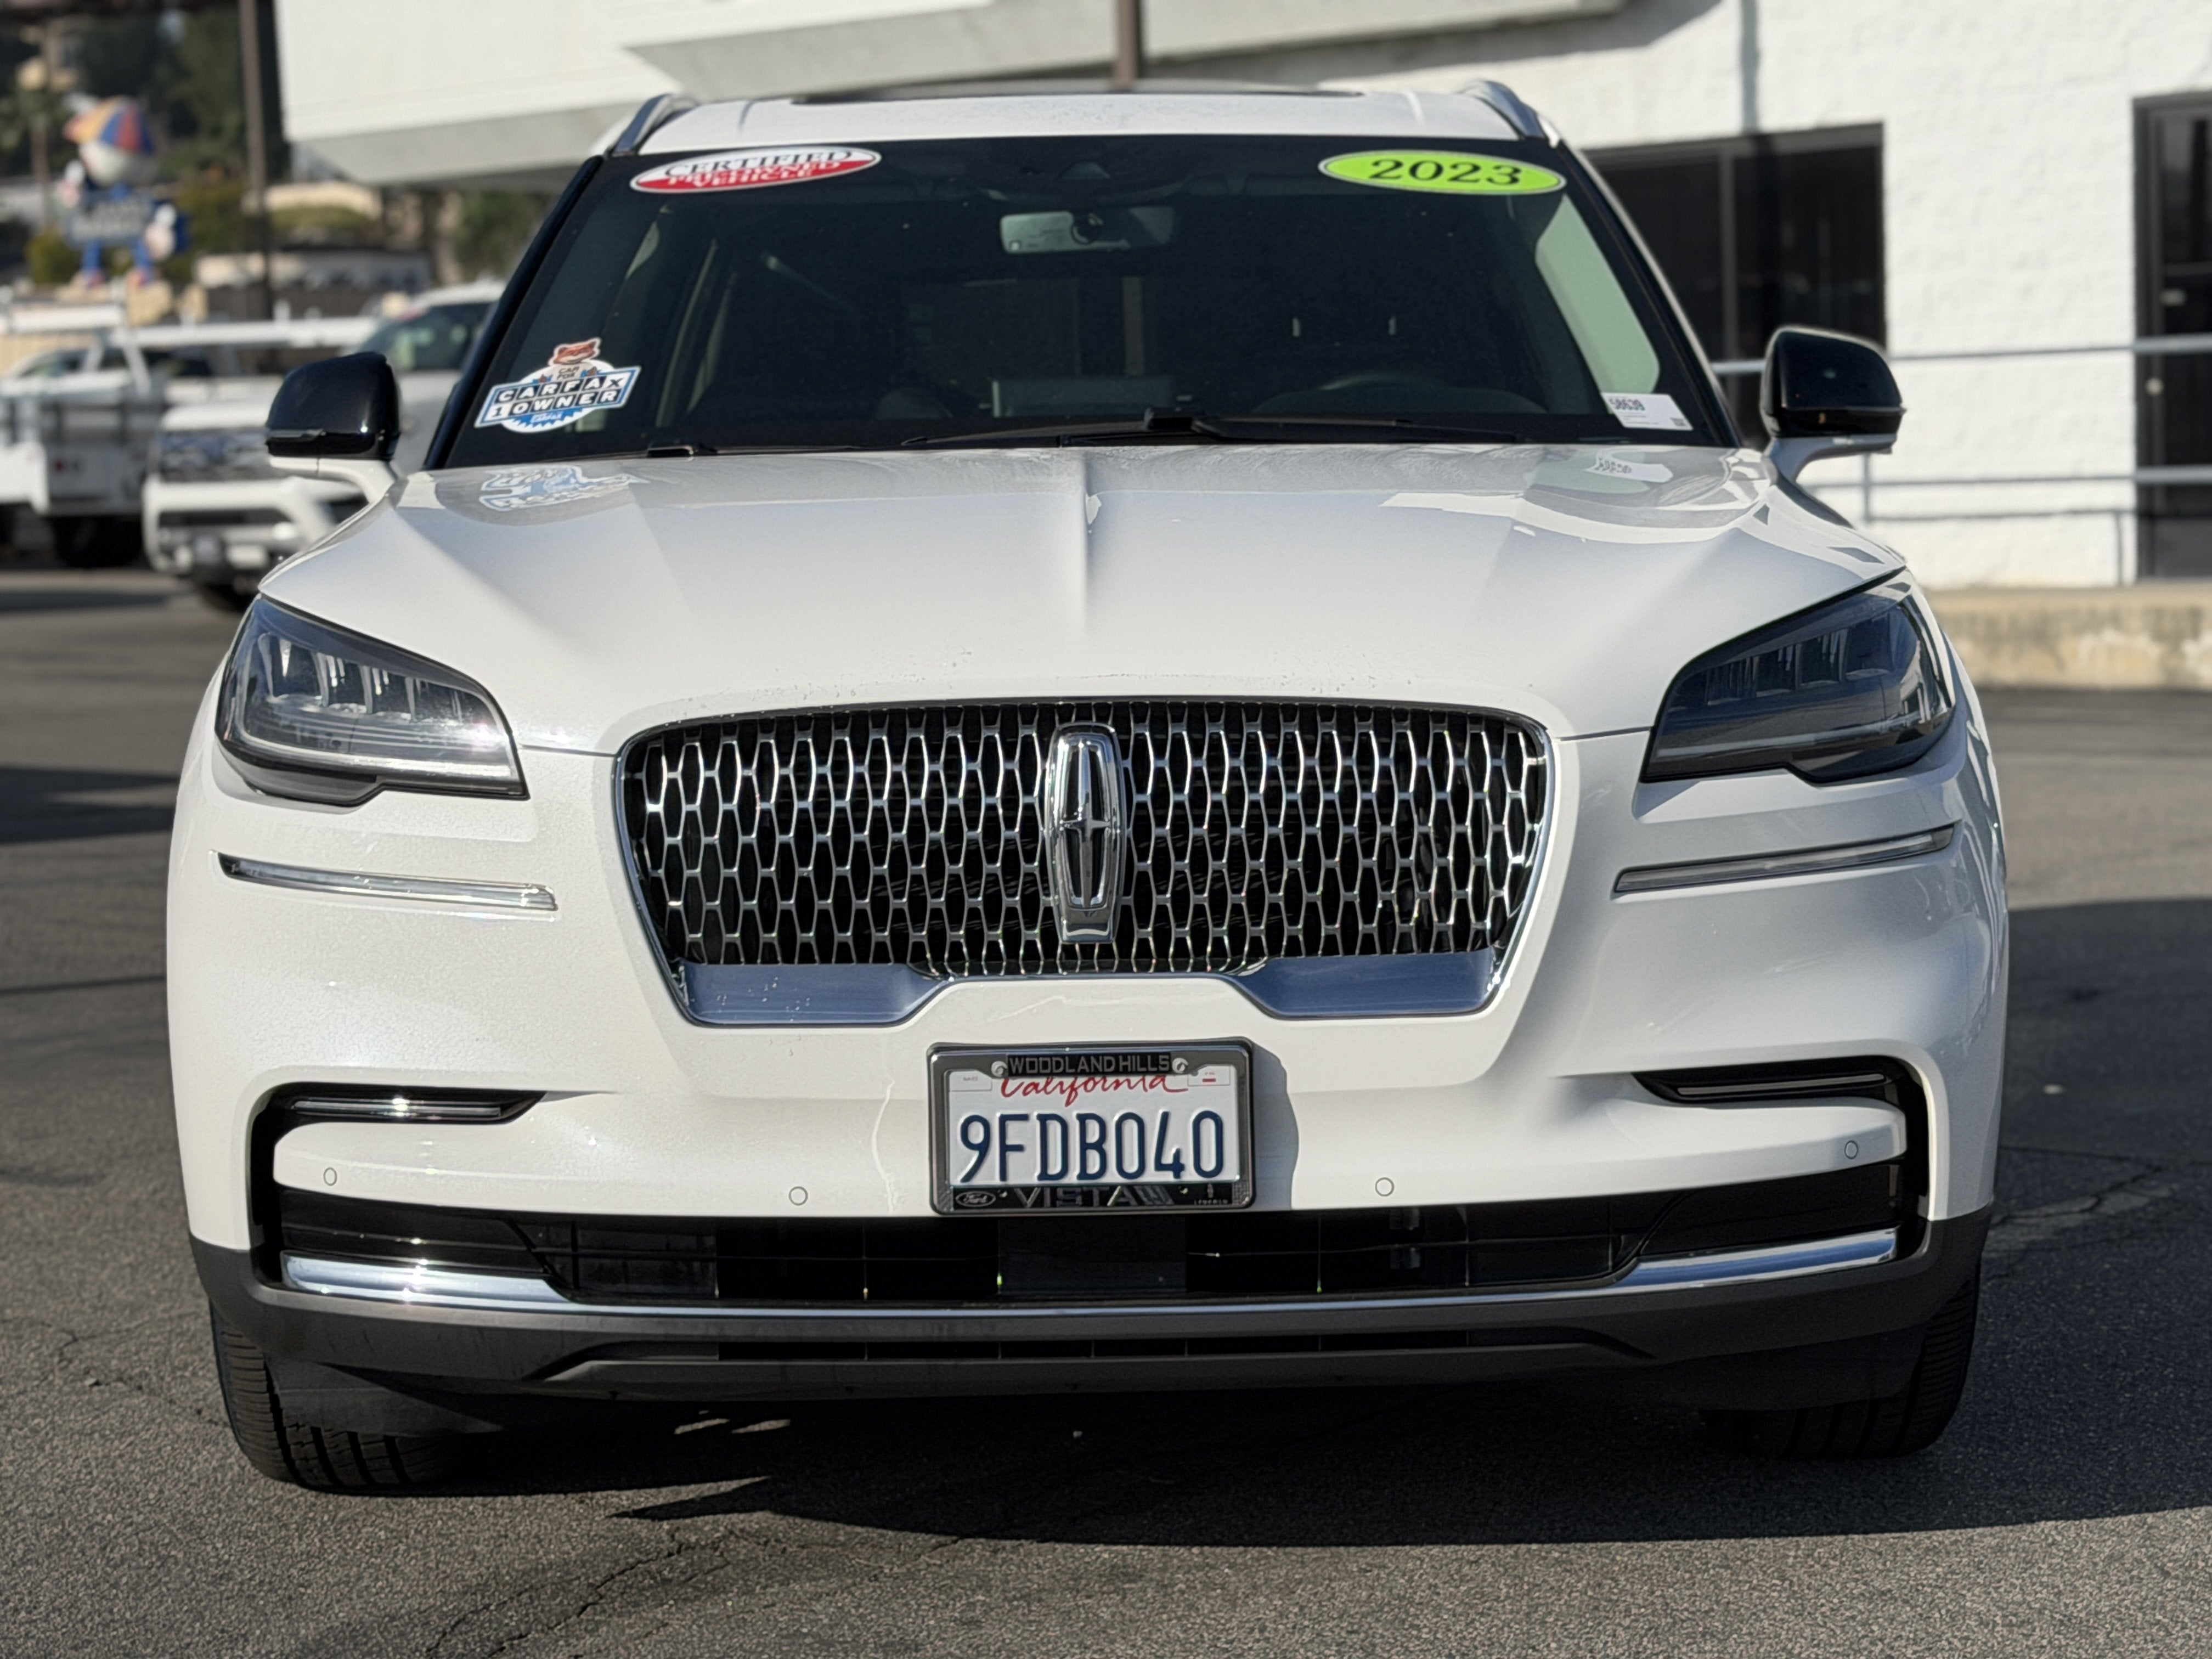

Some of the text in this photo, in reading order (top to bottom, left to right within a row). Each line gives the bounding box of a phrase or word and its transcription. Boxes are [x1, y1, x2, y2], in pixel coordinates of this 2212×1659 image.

[665, 151, 852, 177] CERTIFIED
[1368, 159, 1522, 185] 2023
[692, 169, 812, 187] VEHICLE
[498, 377, 624, 402] CARFAX
[491, 391, 617, 418] 1 OWNER
[1009, 1054, 1170, 1074] WOODLAND HILLS
[1001, 1075, 1188, 1107] California
[960, 1110, 1224, 1182] 9FDB040
[1013, 1186, 1139, 1207] VISTA
